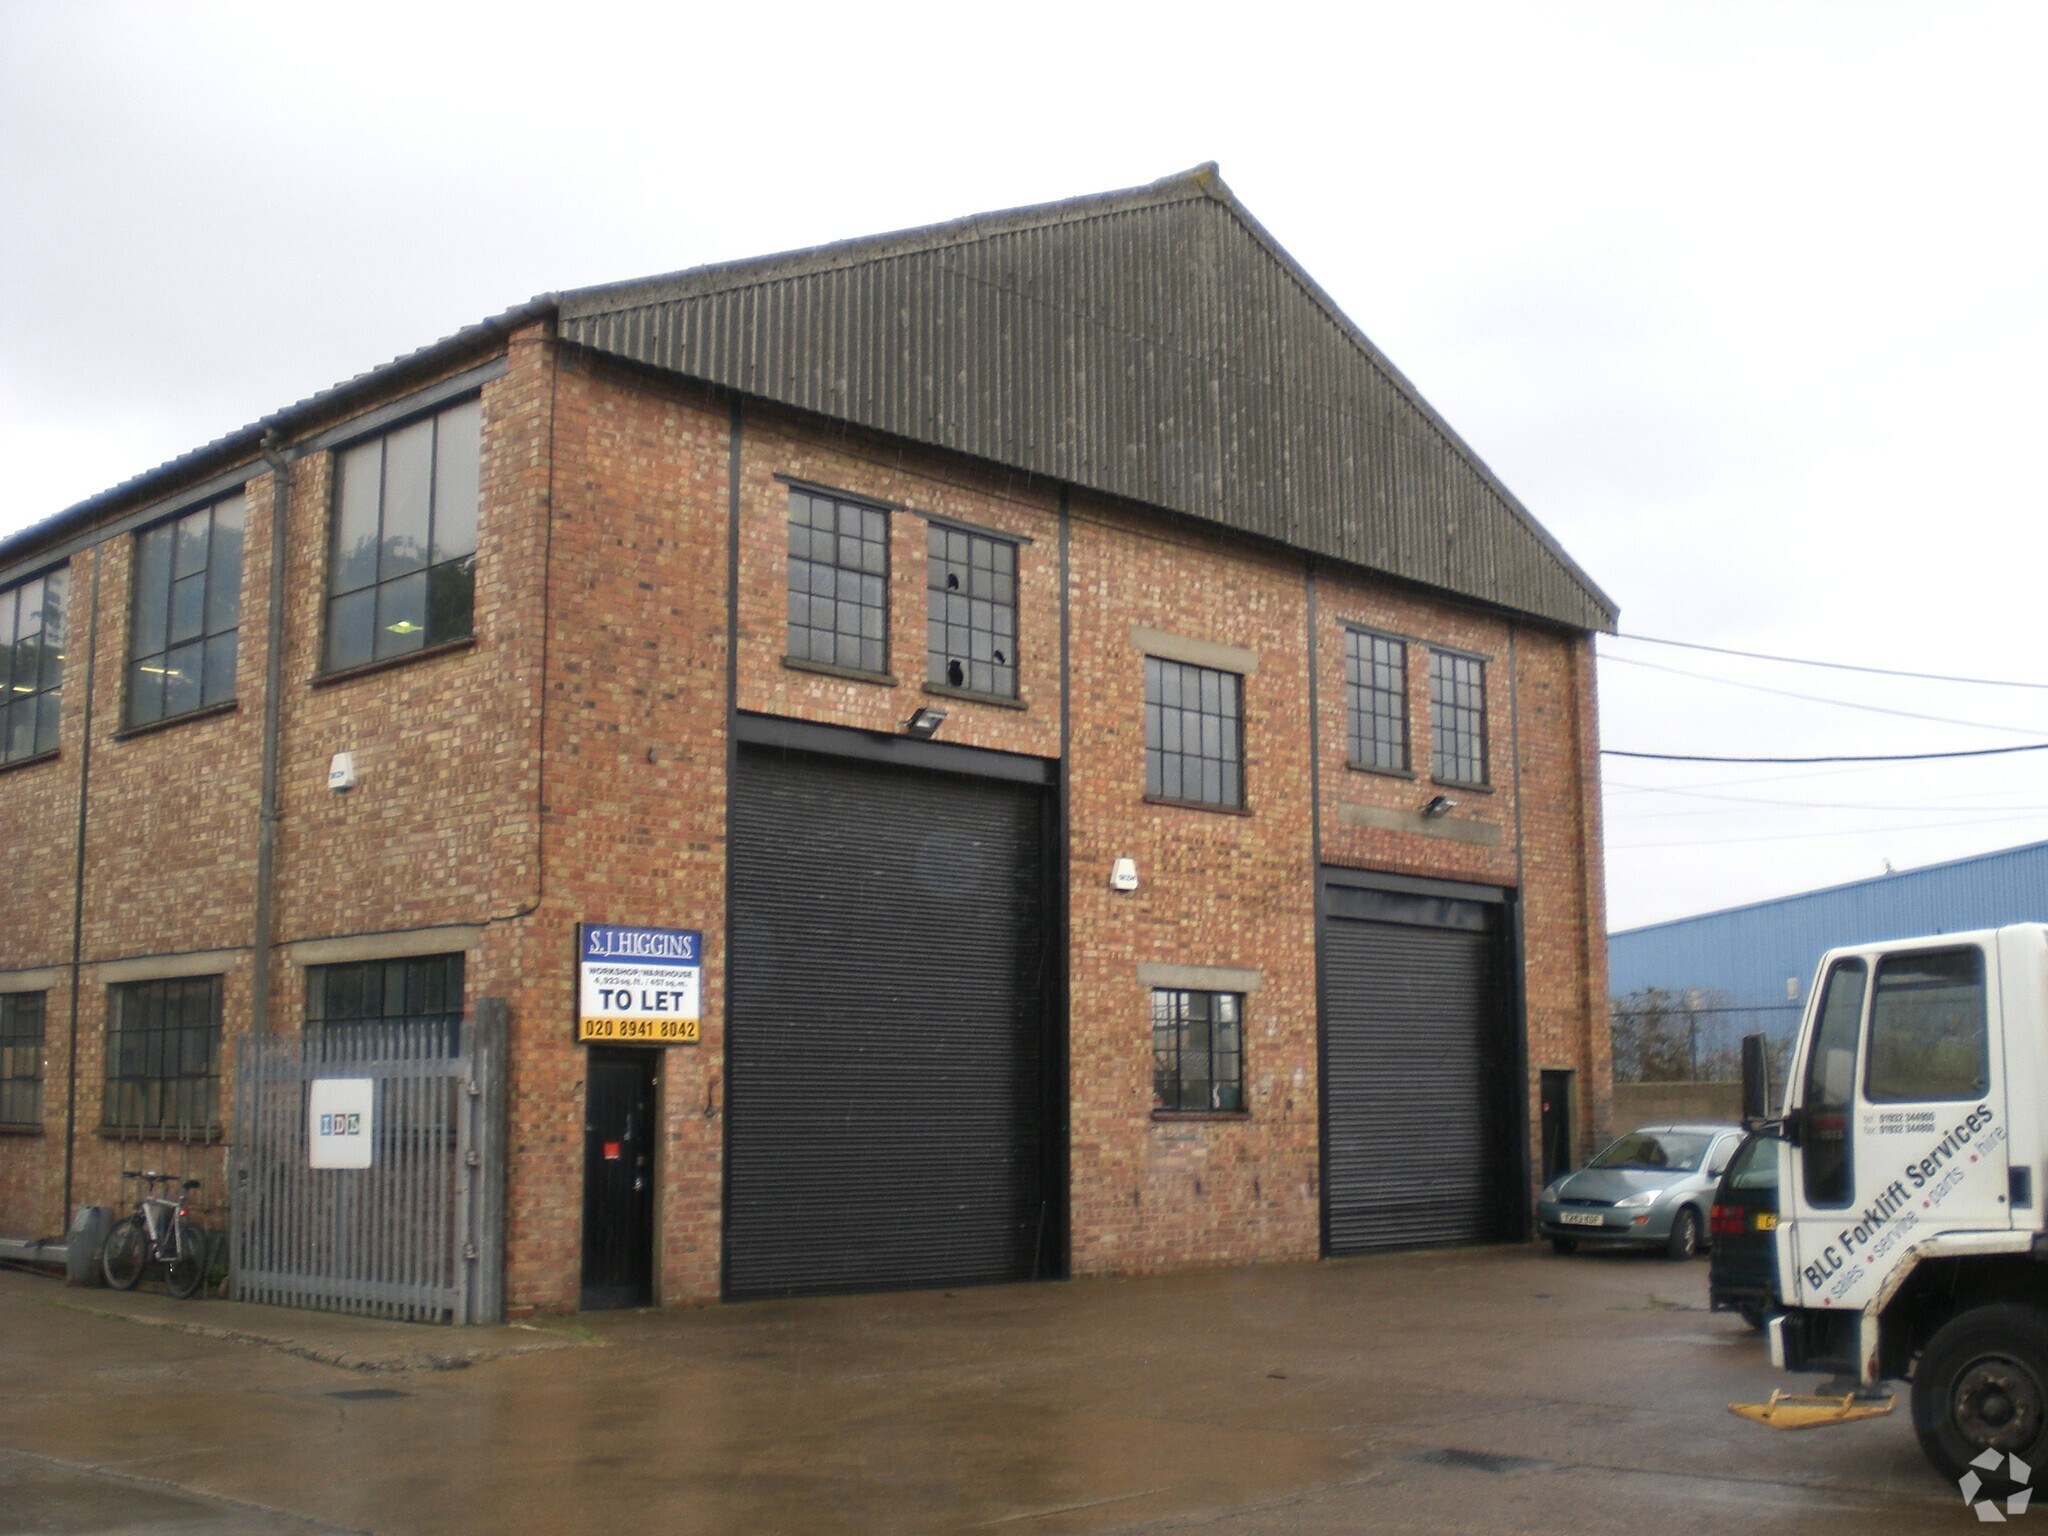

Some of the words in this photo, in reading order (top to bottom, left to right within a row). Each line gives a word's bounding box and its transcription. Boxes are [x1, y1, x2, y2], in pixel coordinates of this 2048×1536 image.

[618, 932, 692, 958] HIGGINS
[598, 988, 633, 1011] TO
[641, 990, 684, 1012] LET
[586, 1020, 613, 1036] 020
[620, 1021, 653, 1037] 8941
[661, 1021, 695, 1037] 8042
[1804, 1245, 1843, 1290] BLC
[1838, 1180, 1912, 1255] Forklift
[1905, 1104, 1993, 1188] Services
[1830, 1264, 1864, 1299] sales
[1873, 1210, 1919, 1258] service
[1929, 1166, 1965, 1208] parts
[1974, 1126, 2006, 1157] hire
